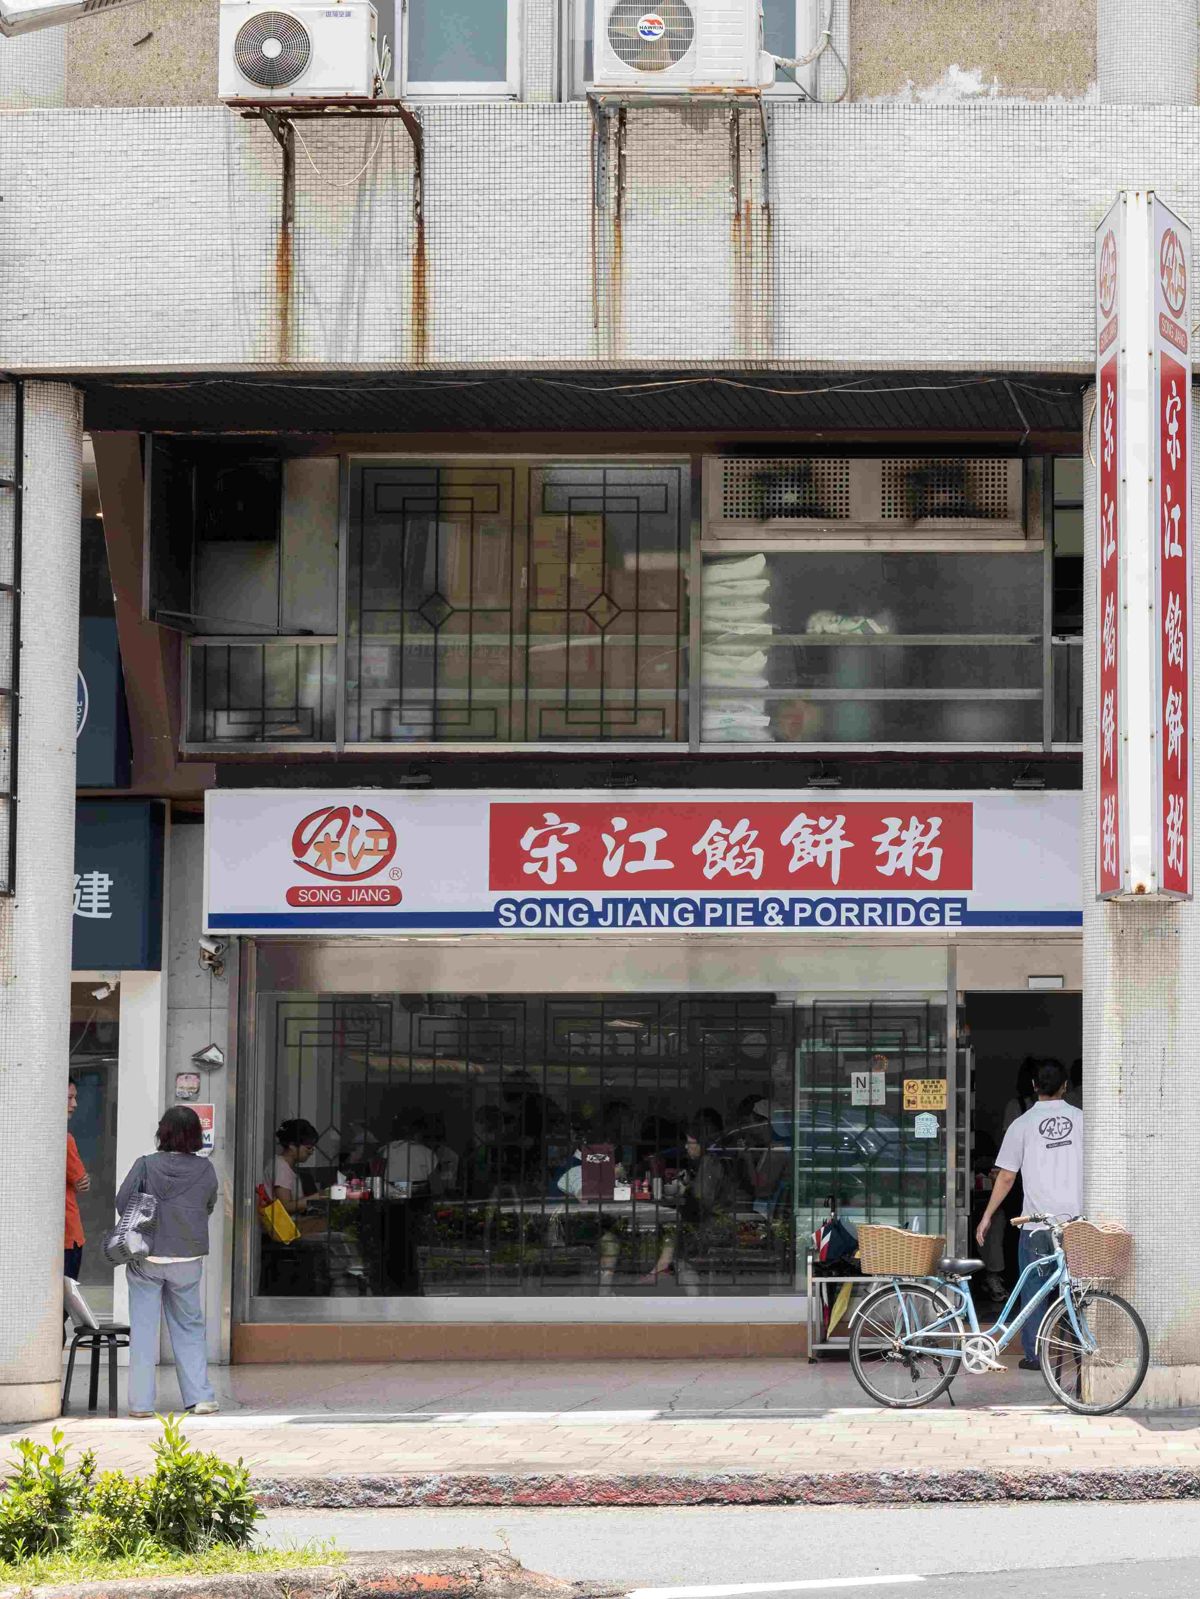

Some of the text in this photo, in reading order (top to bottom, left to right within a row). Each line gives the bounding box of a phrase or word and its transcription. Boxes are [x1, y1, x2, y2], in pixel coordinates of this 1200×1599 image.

[1102, 381, 1116, 877] 宋江餡餅粥
[1164, 379, 1184, 878] 宋江餡餅粥
[519, 812, 945, 885] 宋江餡餅粥
[298, 889, 391, 902] SONG JIANG
[498, 902, 963, 927] SONG JIANG PIE & PORRIDGE
